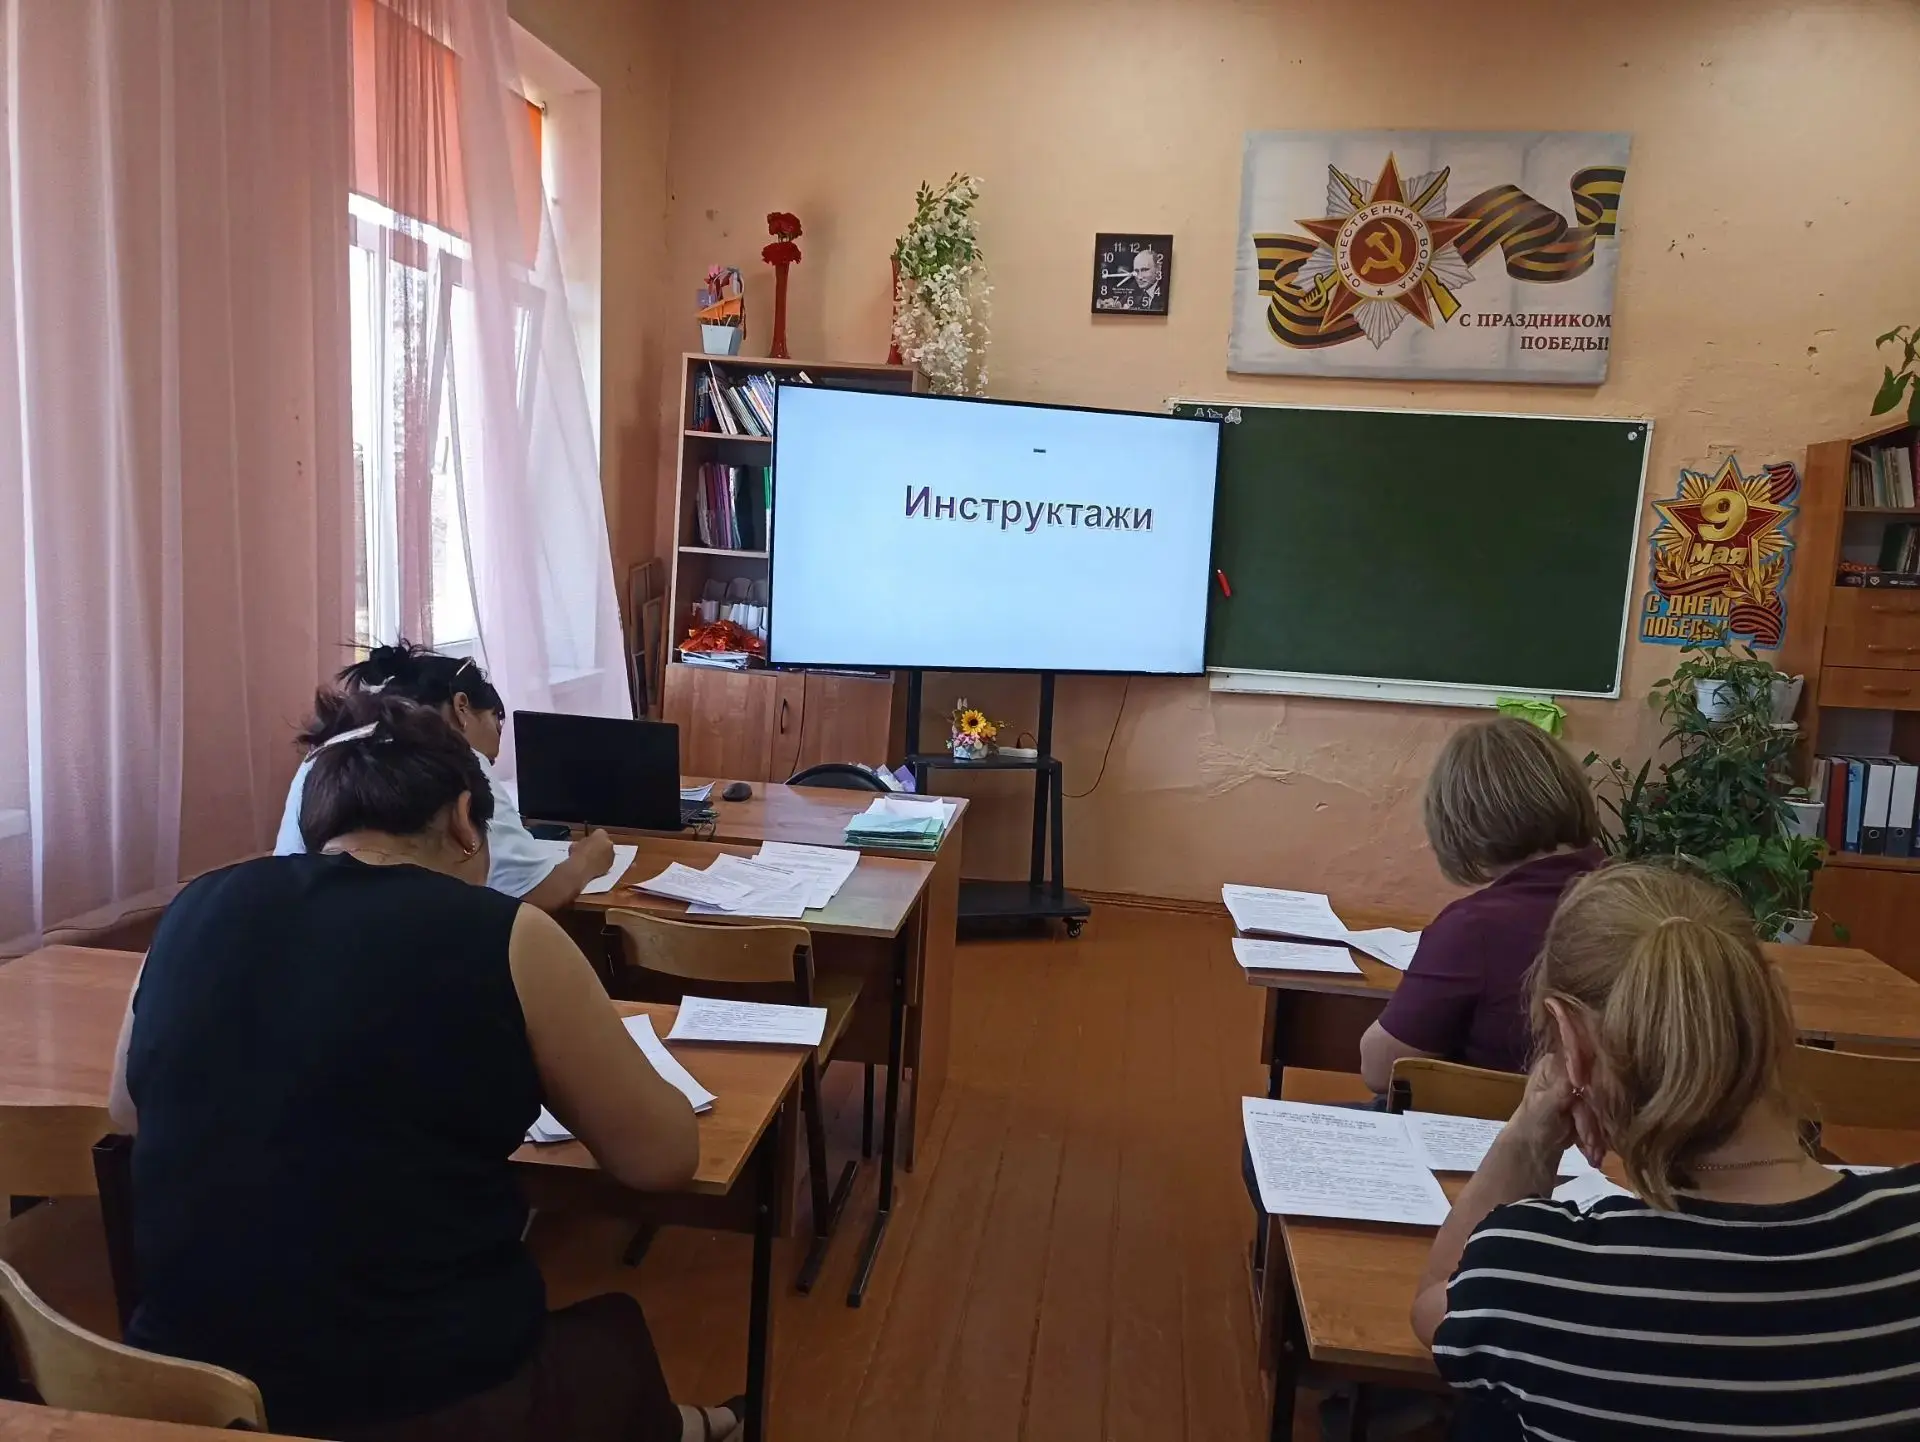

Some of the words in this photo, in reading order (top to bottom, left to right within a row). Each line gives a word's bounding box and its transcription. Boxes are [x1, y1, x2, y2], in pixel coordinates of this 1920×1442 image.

[1113, 242, 1122, 252] 11
[1129, 242, 1140, 252] 12
[1147, 243, 1152, 252] 1
[1340, 205, 1424, 288] ОТЕЧЕСТВЕННАЯ
[1103, 252, 1114, 263] 10
[1156, 253, 1164, 264] 2
[1101, 269, 1109, 279] 9
[1155, 271, 1162, 281] 3
[1100, 286, 1108, 296] 8
[1154, 287, 1161, 297] 4
[1113, 296, 1119, 306] 7
[1127, 296, 1134, 306] 6
[1141, 296, 1149, 307] 5
[1459, 313, 1472, 327] С
[1476, 313, 1612, 329] ПРАЗДНИКОМ
[1519, 336, 1609, 352] ПОБЕДЫ!
[904, 484, 1154, 533] Инструктажи
[1697, 489, 1749, 542] 9
[1689, 543, 1749, 566] Мая
[1646, 593, 1661, 613] С
[1666, 594, 1731, 617] ДНЕМ
